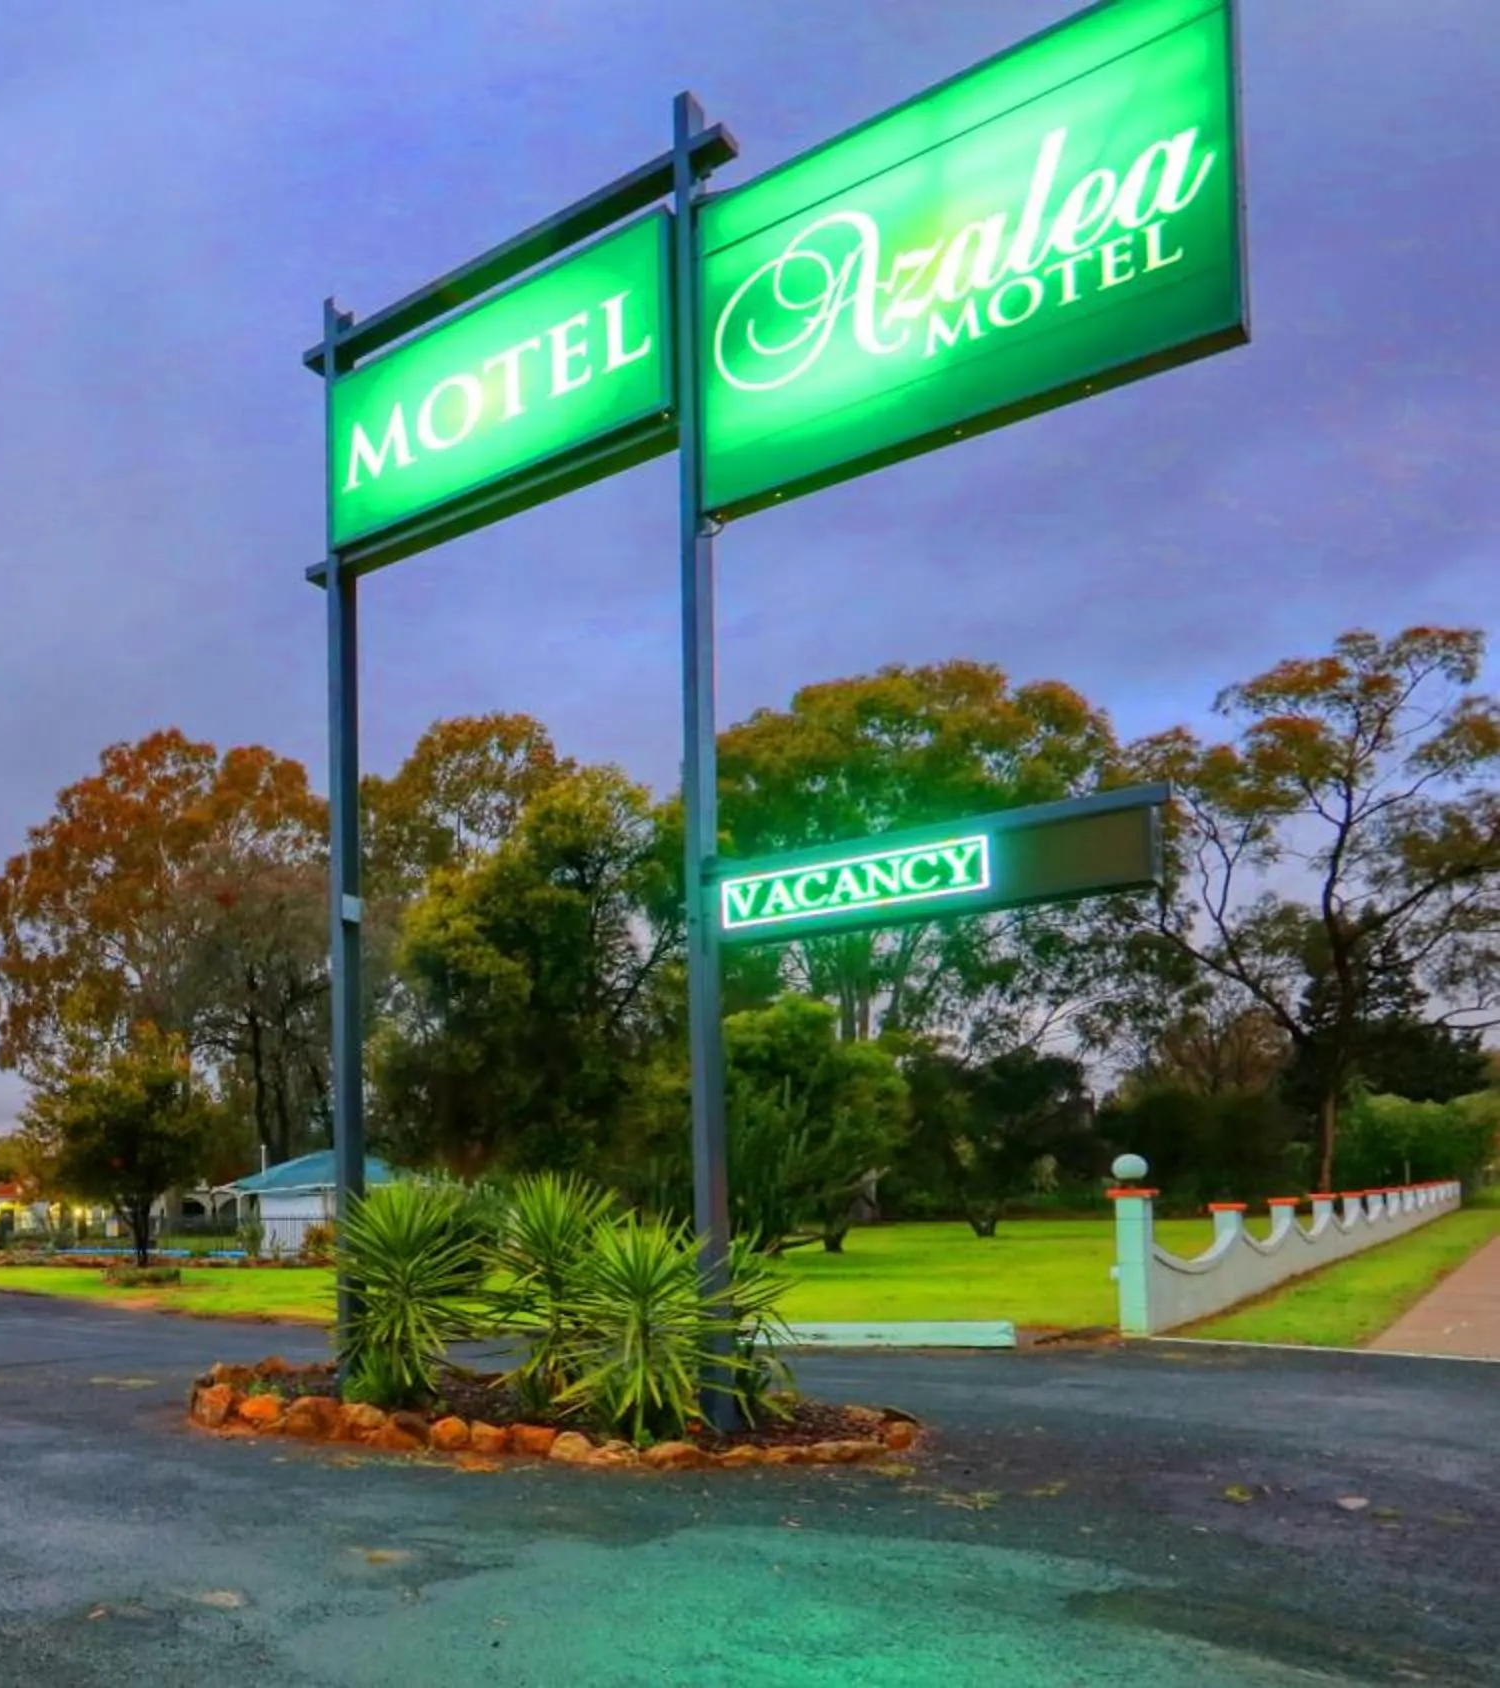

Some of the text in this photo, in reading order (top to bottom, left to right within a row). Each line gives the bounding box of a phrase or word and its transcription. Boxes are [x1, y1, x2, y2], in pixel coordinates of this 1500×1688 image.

[714, 127, 1213, 391] Azalea
[925, 222, 1182, 356] MOTEL
[343, 292, 651, 490] MOTEL
[728, 844, 978, 917] VACANCY
